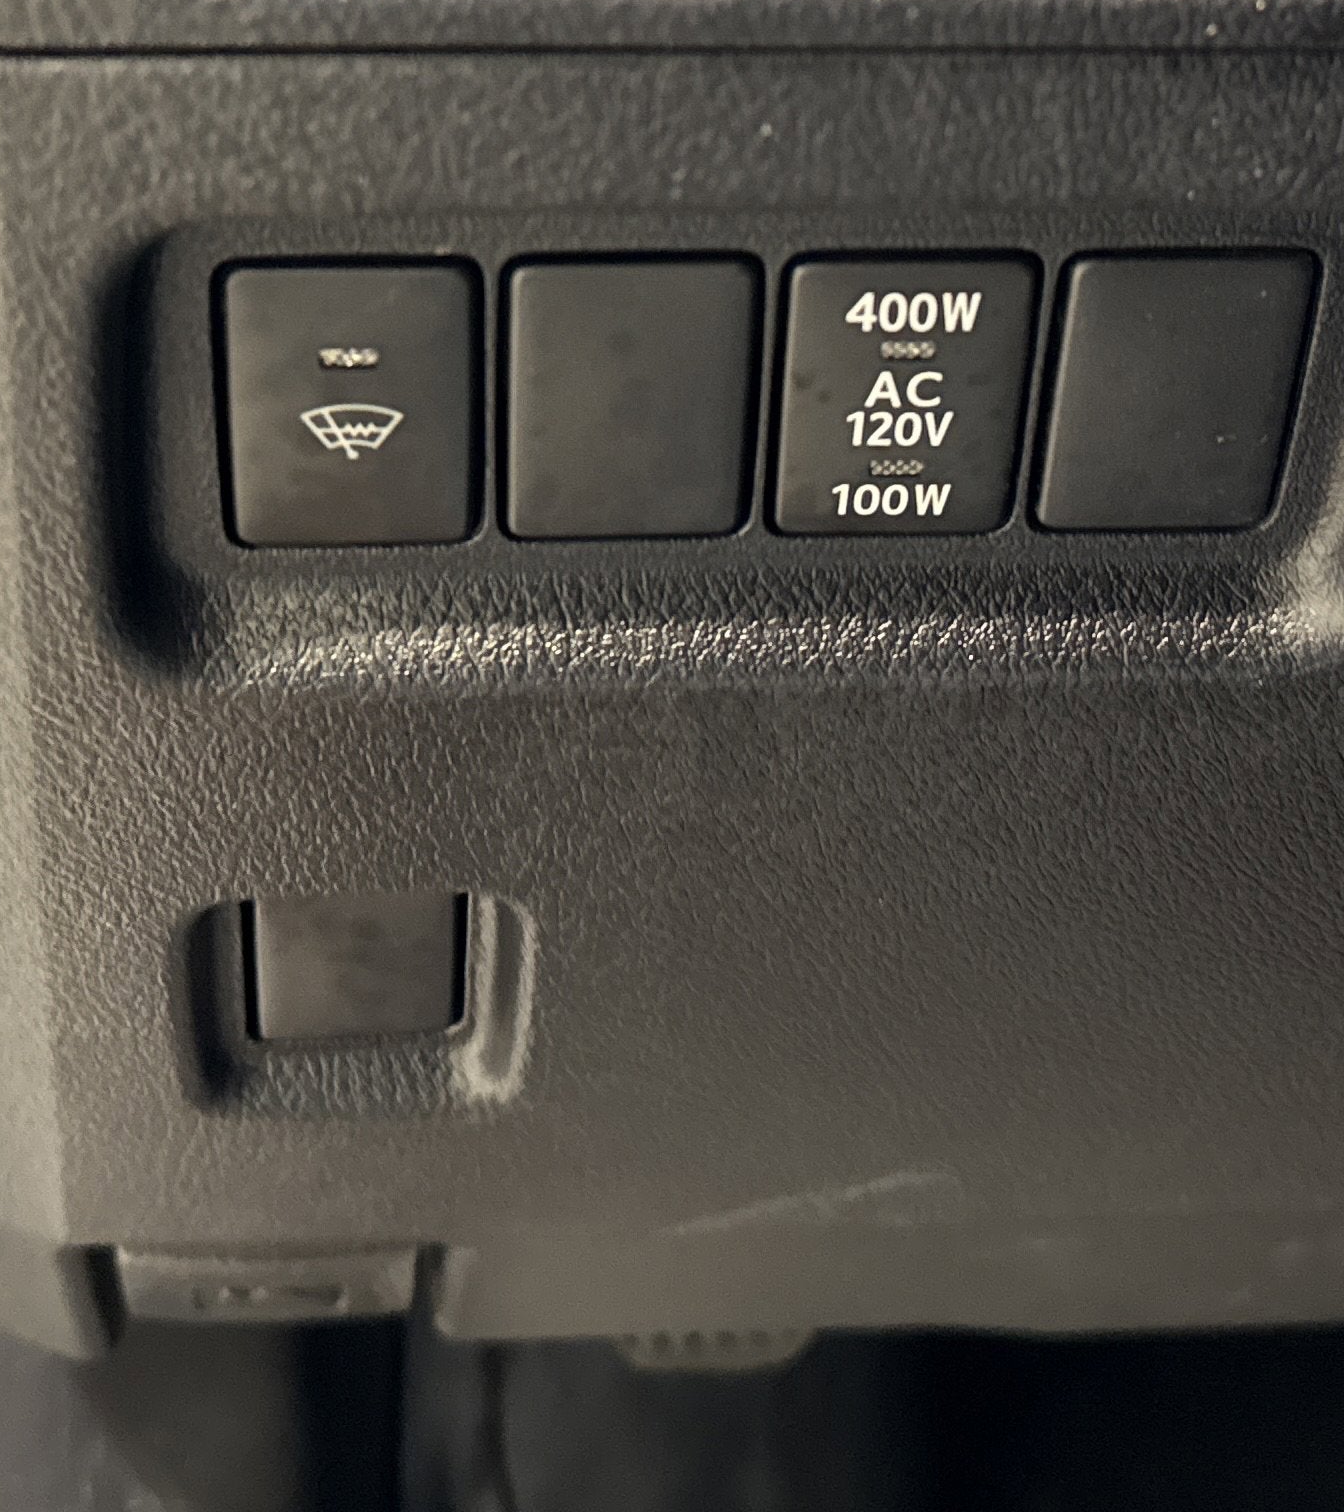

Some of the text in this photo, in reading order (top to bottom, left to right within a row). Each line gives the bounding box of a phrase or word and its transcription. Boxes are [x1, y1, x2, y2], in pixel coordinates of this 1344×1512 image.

[845, 292, 982, 332] 400W
[864, 371, 944, 408] AC
[846, 411, 954, 447] 120V
[831, 484, 951, 516] 100W
